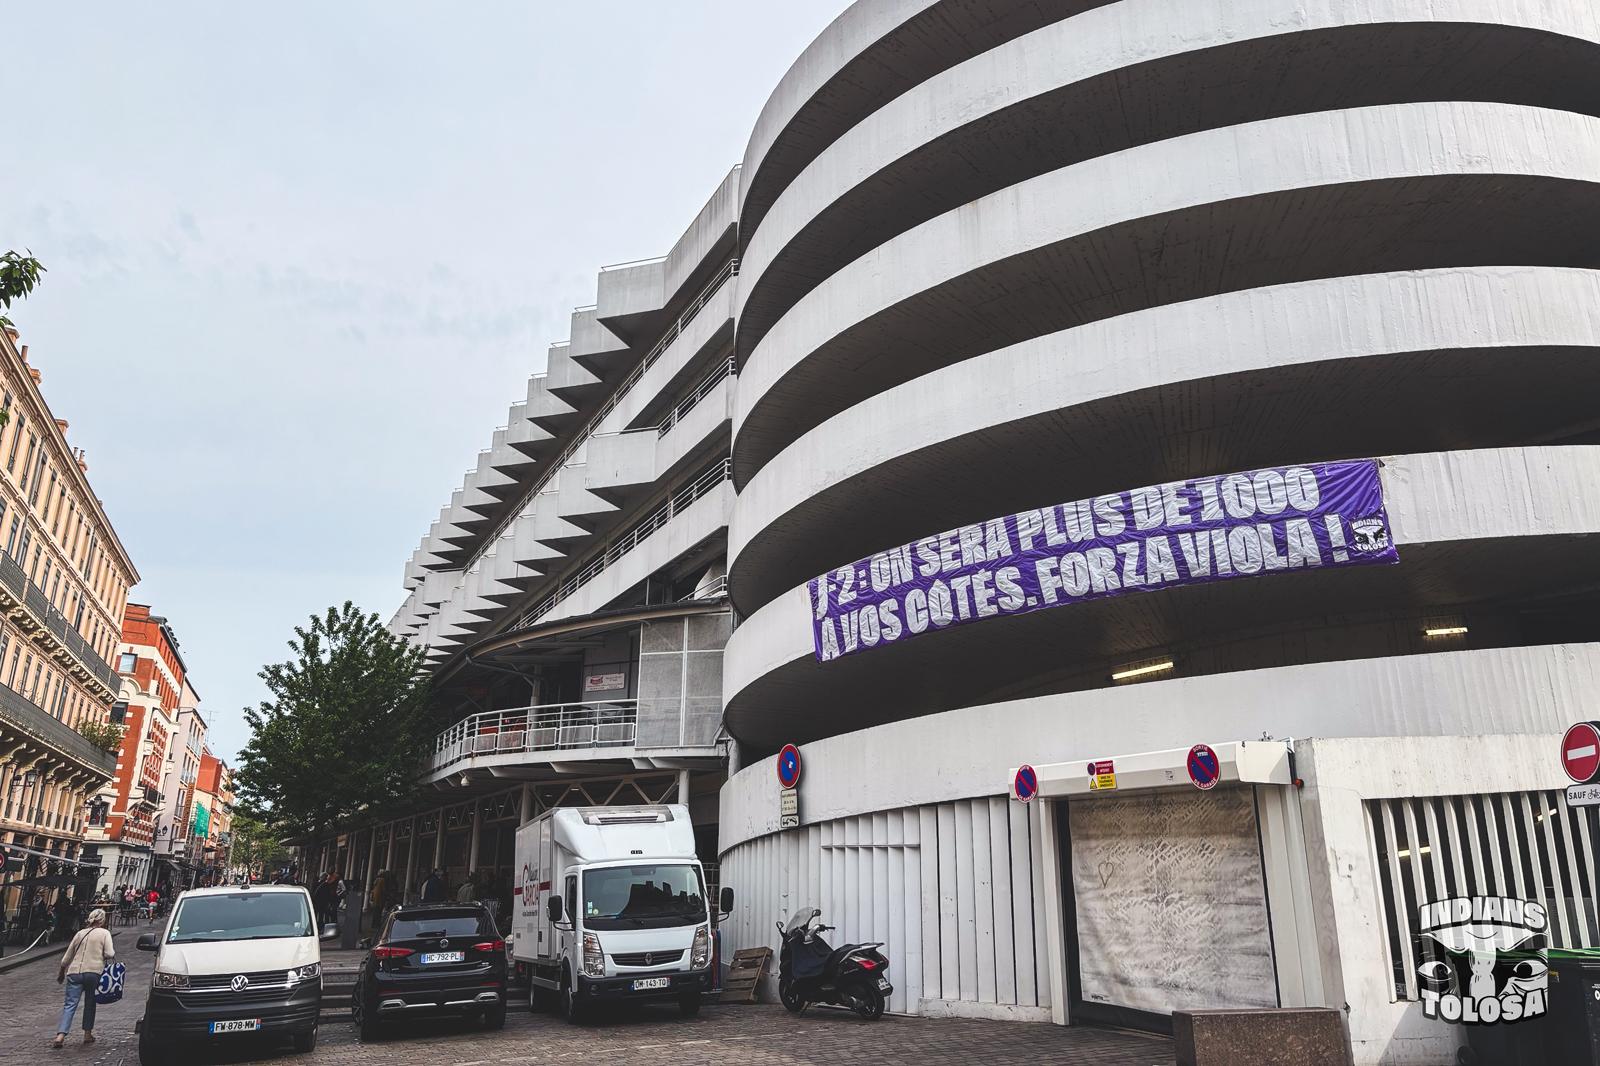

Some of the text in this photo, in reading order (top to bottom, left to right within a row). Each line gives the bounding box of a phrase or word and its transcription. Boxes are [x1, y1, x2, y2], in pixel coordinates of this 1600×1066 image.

[840, 598, 903, 653] VOS
[1035, 535, 1179, 605] FORZA
[1178, 518, 1322, 578] VIOLA
[870, 545, 913, 593] ON
[915, 517, 1013, 577] SERA
[1016, 494, 1126, 552] PLUS
[1130, 480, 1192, 531] DE
[1195, 467, 1320, 521] 1000
[1568, 790, 1587, 800] SAUF
